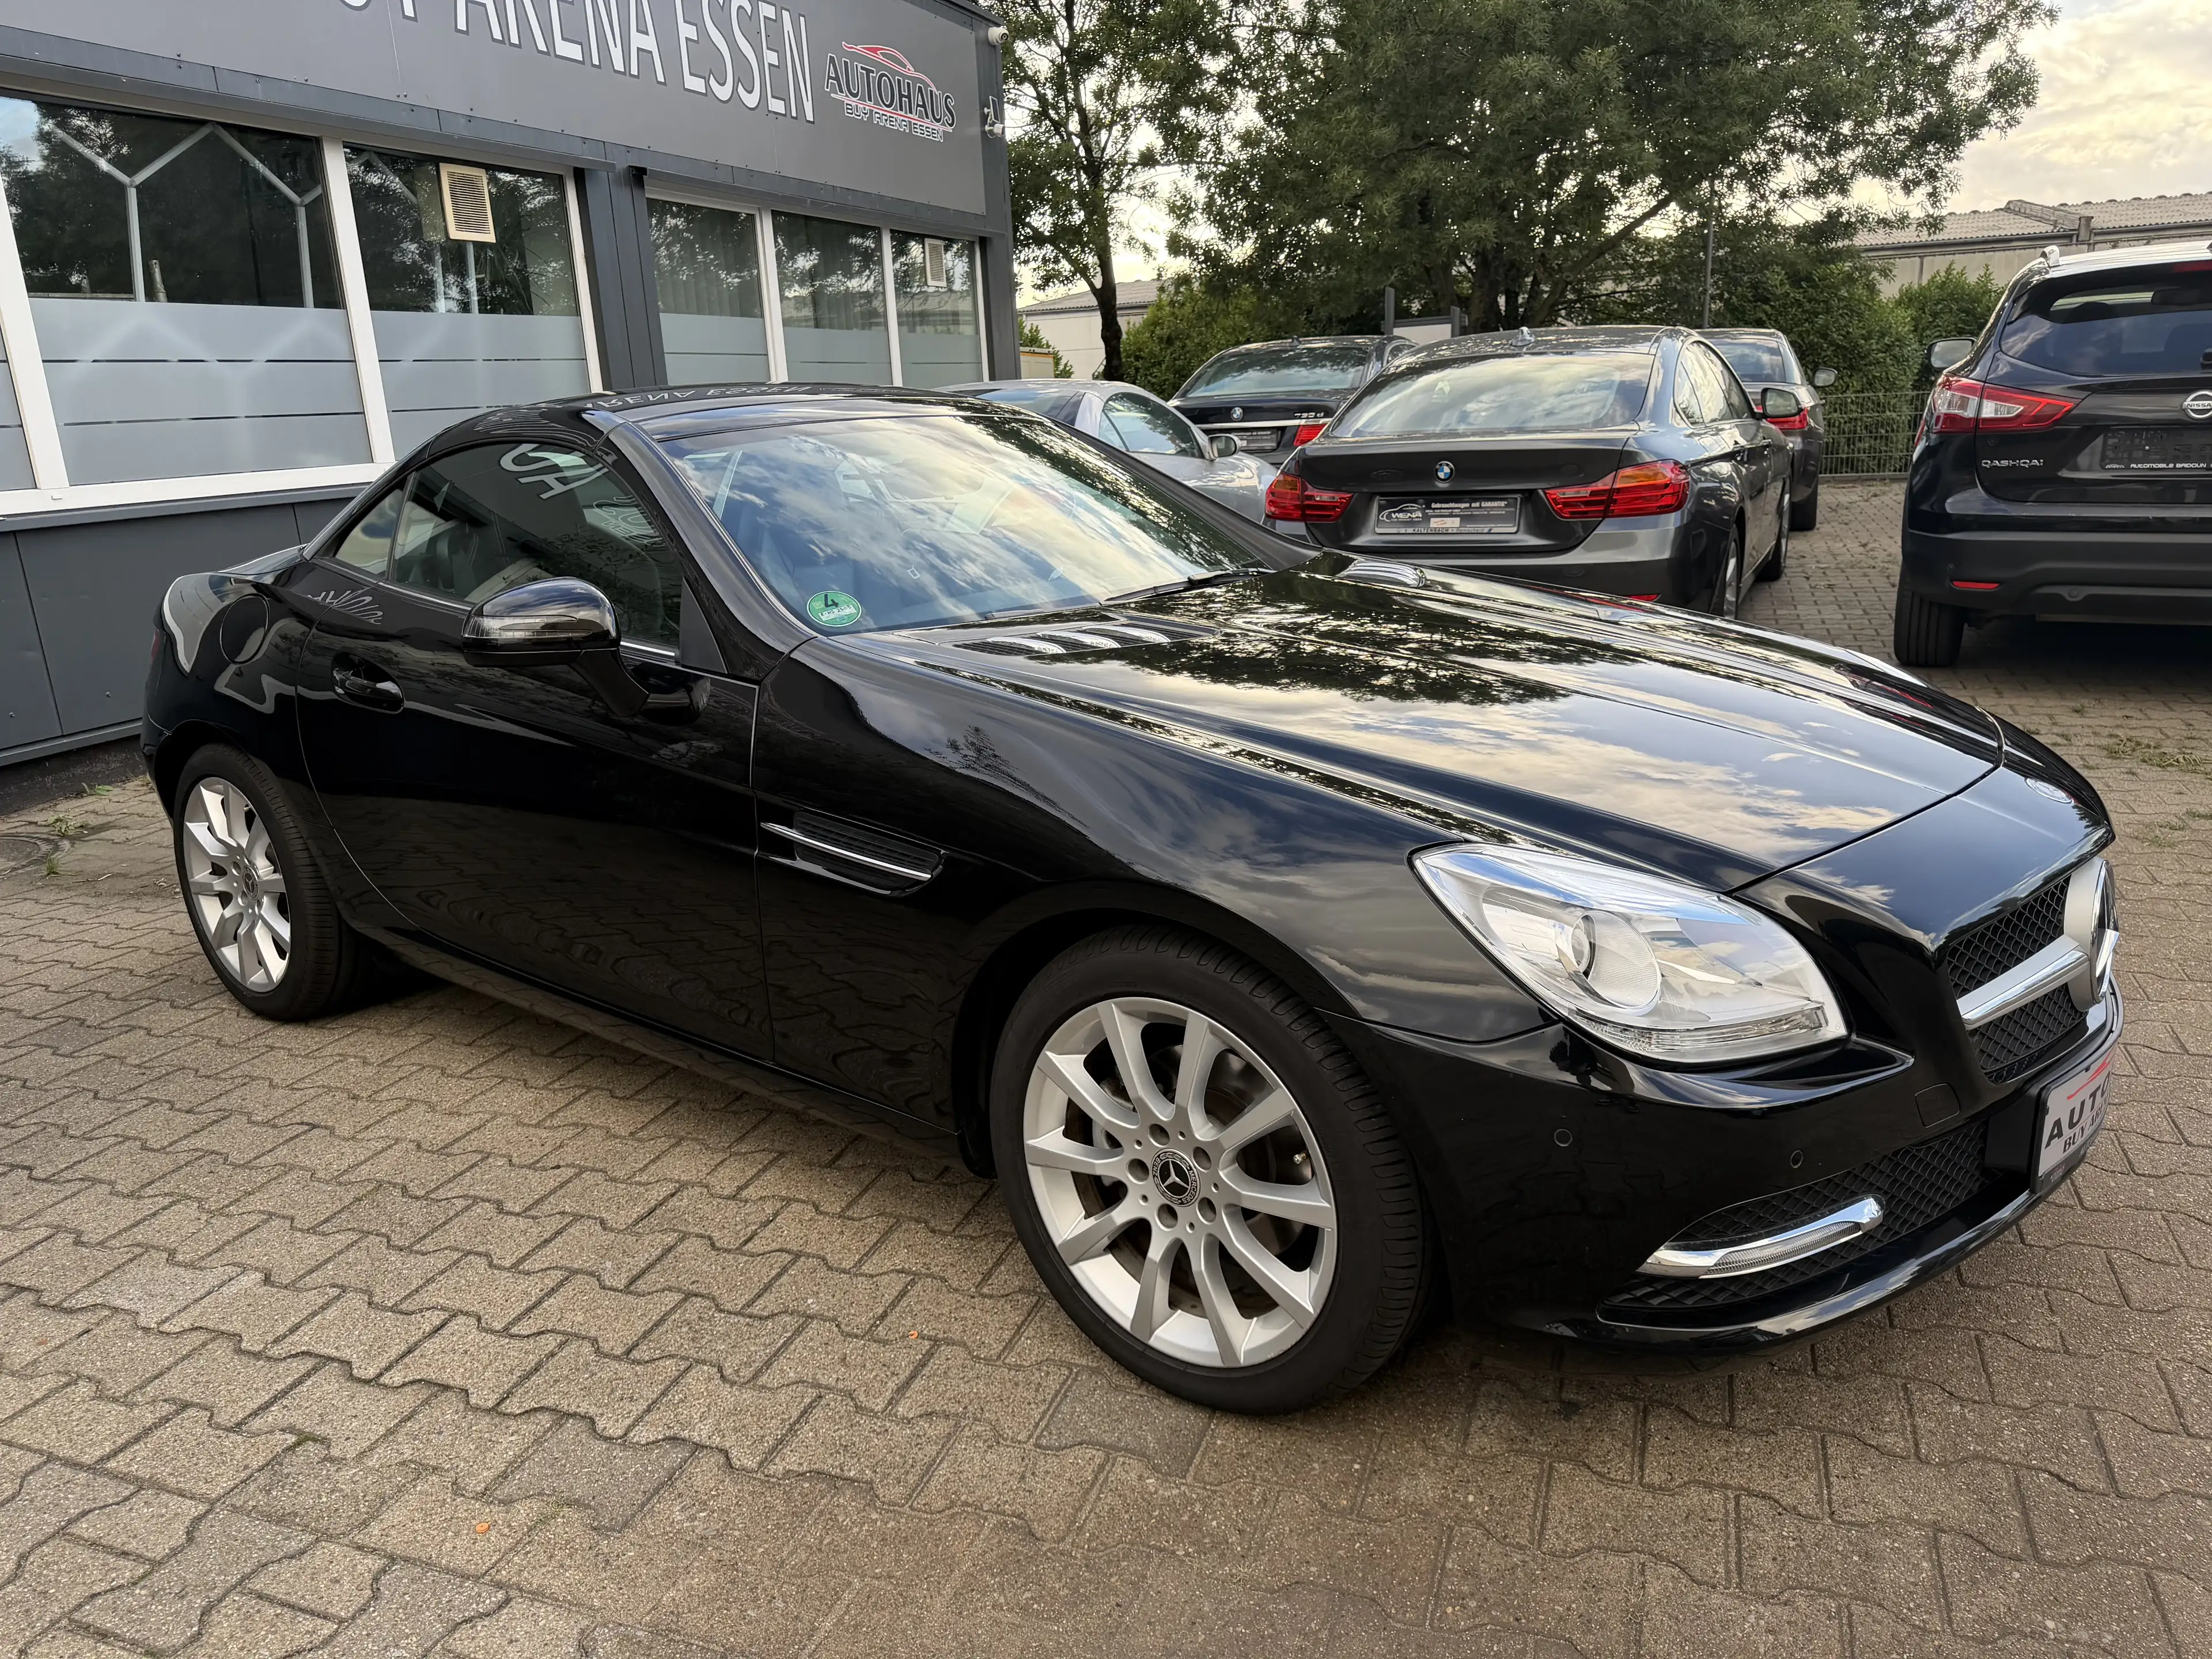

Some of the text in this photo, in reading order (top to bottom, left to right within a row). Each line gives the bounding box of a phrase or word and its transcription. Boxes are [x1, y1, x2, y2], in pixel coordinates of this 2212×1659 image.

[675, 0, 815, 124] ESSEN
[824, 53, 956, 128] AUTOHAUS
[844, 101, 944, 142] BUY ARENA ESSEN
[1982, 459, 2044, 468] QASHQAI
[824, 594, 839, 607] 4
[2063, 1120, 2087, 1154] BUY
[1153, 1158, 1161, 1176] BENZ
[1182, 1170, 1197, 1203] MERCEDES
